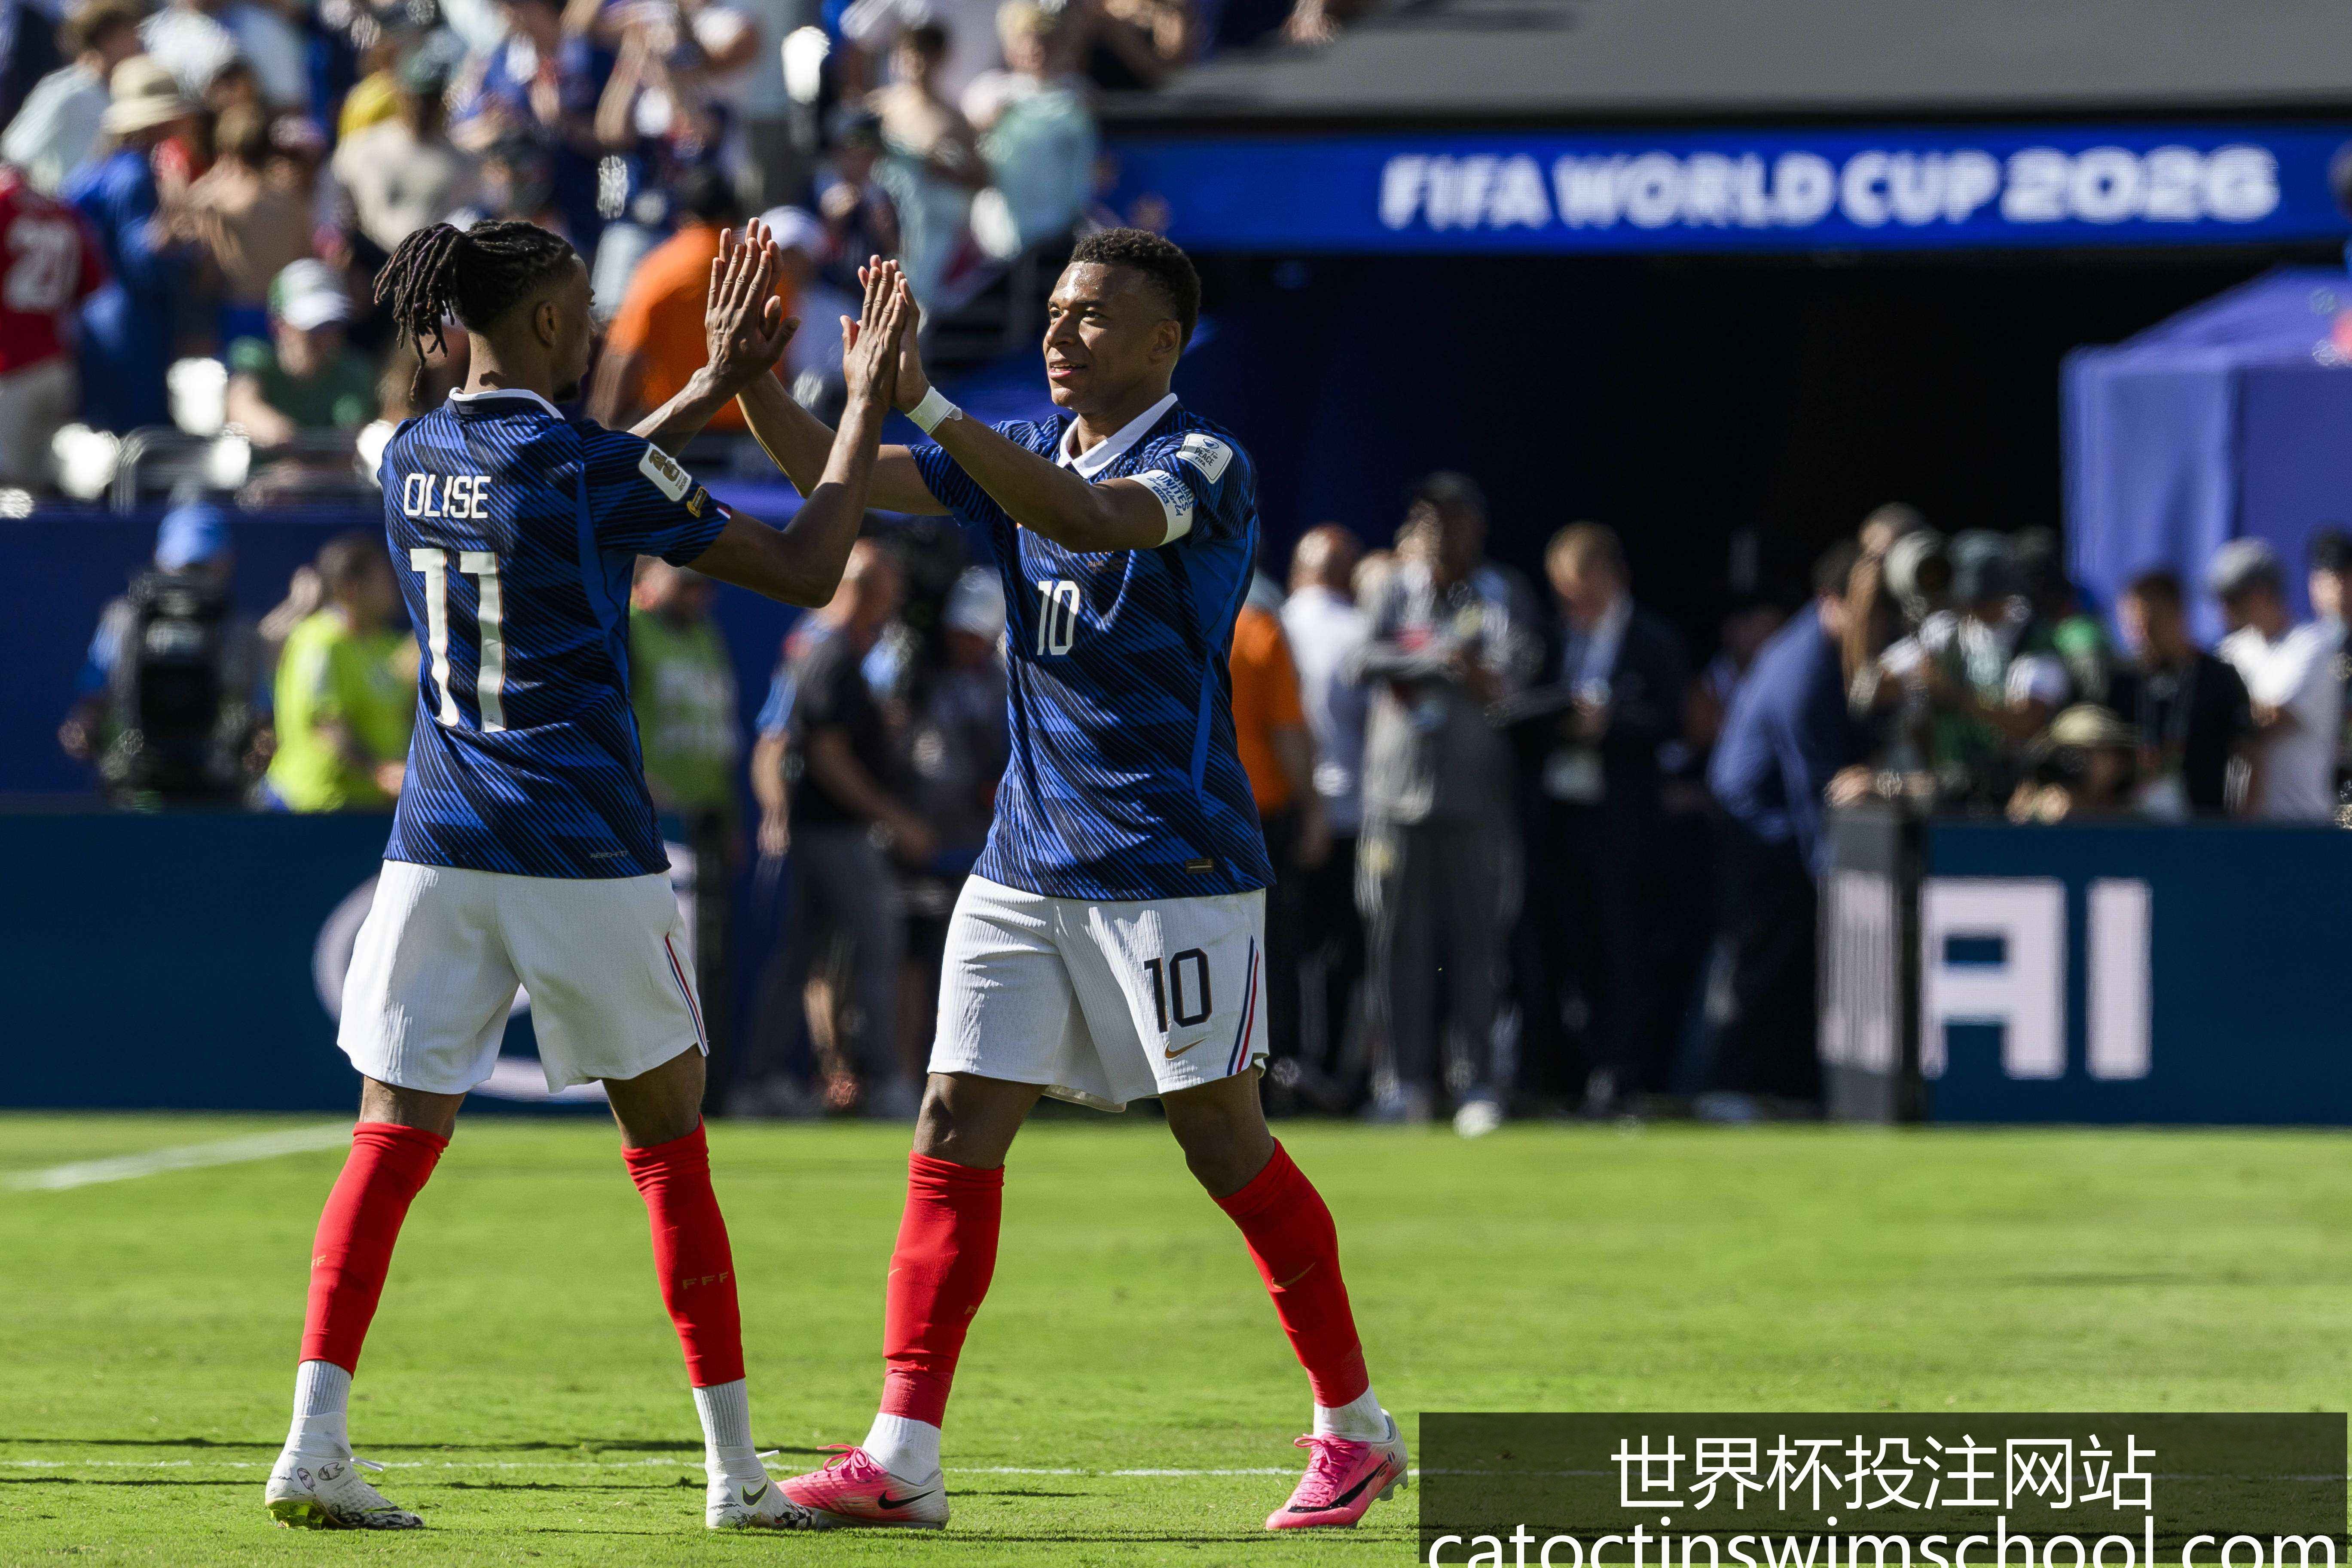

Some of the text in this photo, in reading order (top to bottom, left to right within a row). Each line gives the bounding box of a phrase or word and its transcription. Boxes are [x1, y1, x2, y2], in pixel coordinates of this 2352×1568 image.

[1382, 145, 2280, 229] FIFA WORLD CUP 2026
[1194, 446, 1215, 467] PEACE
[403, 473, 491, 519] OLISE
[1156, 474, 1189, 511] UNITES
[409, 548, 507, 732] 11
[1037, 581, 1080, 655] 10
[1144, 948, 1213, 1033] 10
[682, 1271, 729, 1290] FFF
